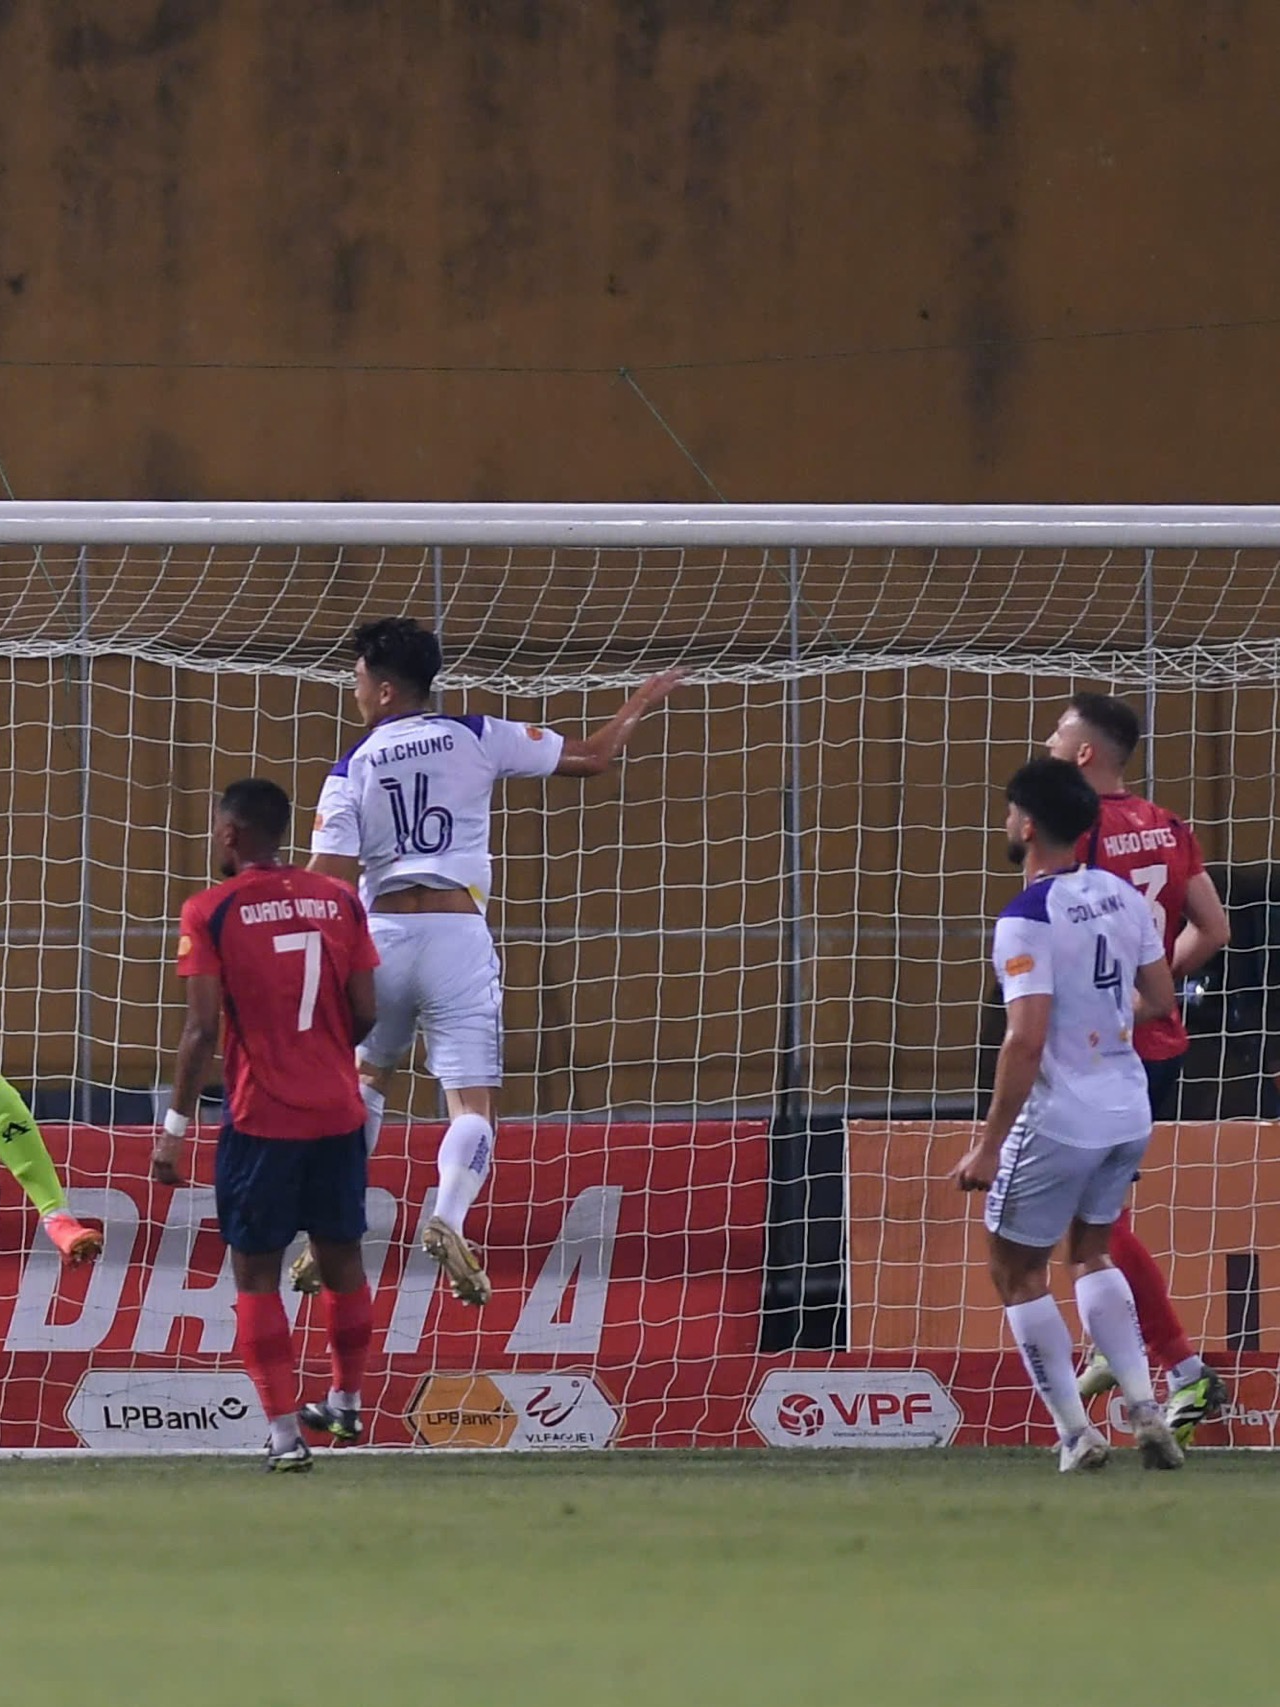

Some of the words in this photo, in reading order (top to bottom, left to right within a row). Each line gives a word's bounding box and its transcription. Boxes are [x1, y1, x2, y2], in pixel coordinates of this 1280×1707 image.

[379, 771, 454, 855] 16
[1103, 832, 1141, 857] HUGO
[240, 900, 294, 925] QUANG
[294, 898, 327, 920] VINH
[327, 901, 343, 920] P.
[272, 931, 322, 1032] 7
[1093, 933, 1123, 1012] 4
[103, 1405, 219, 1429] LPBank
[426, 1411, 493, 1426] LPBank
[828, 1392, 933, 1426] VPF
